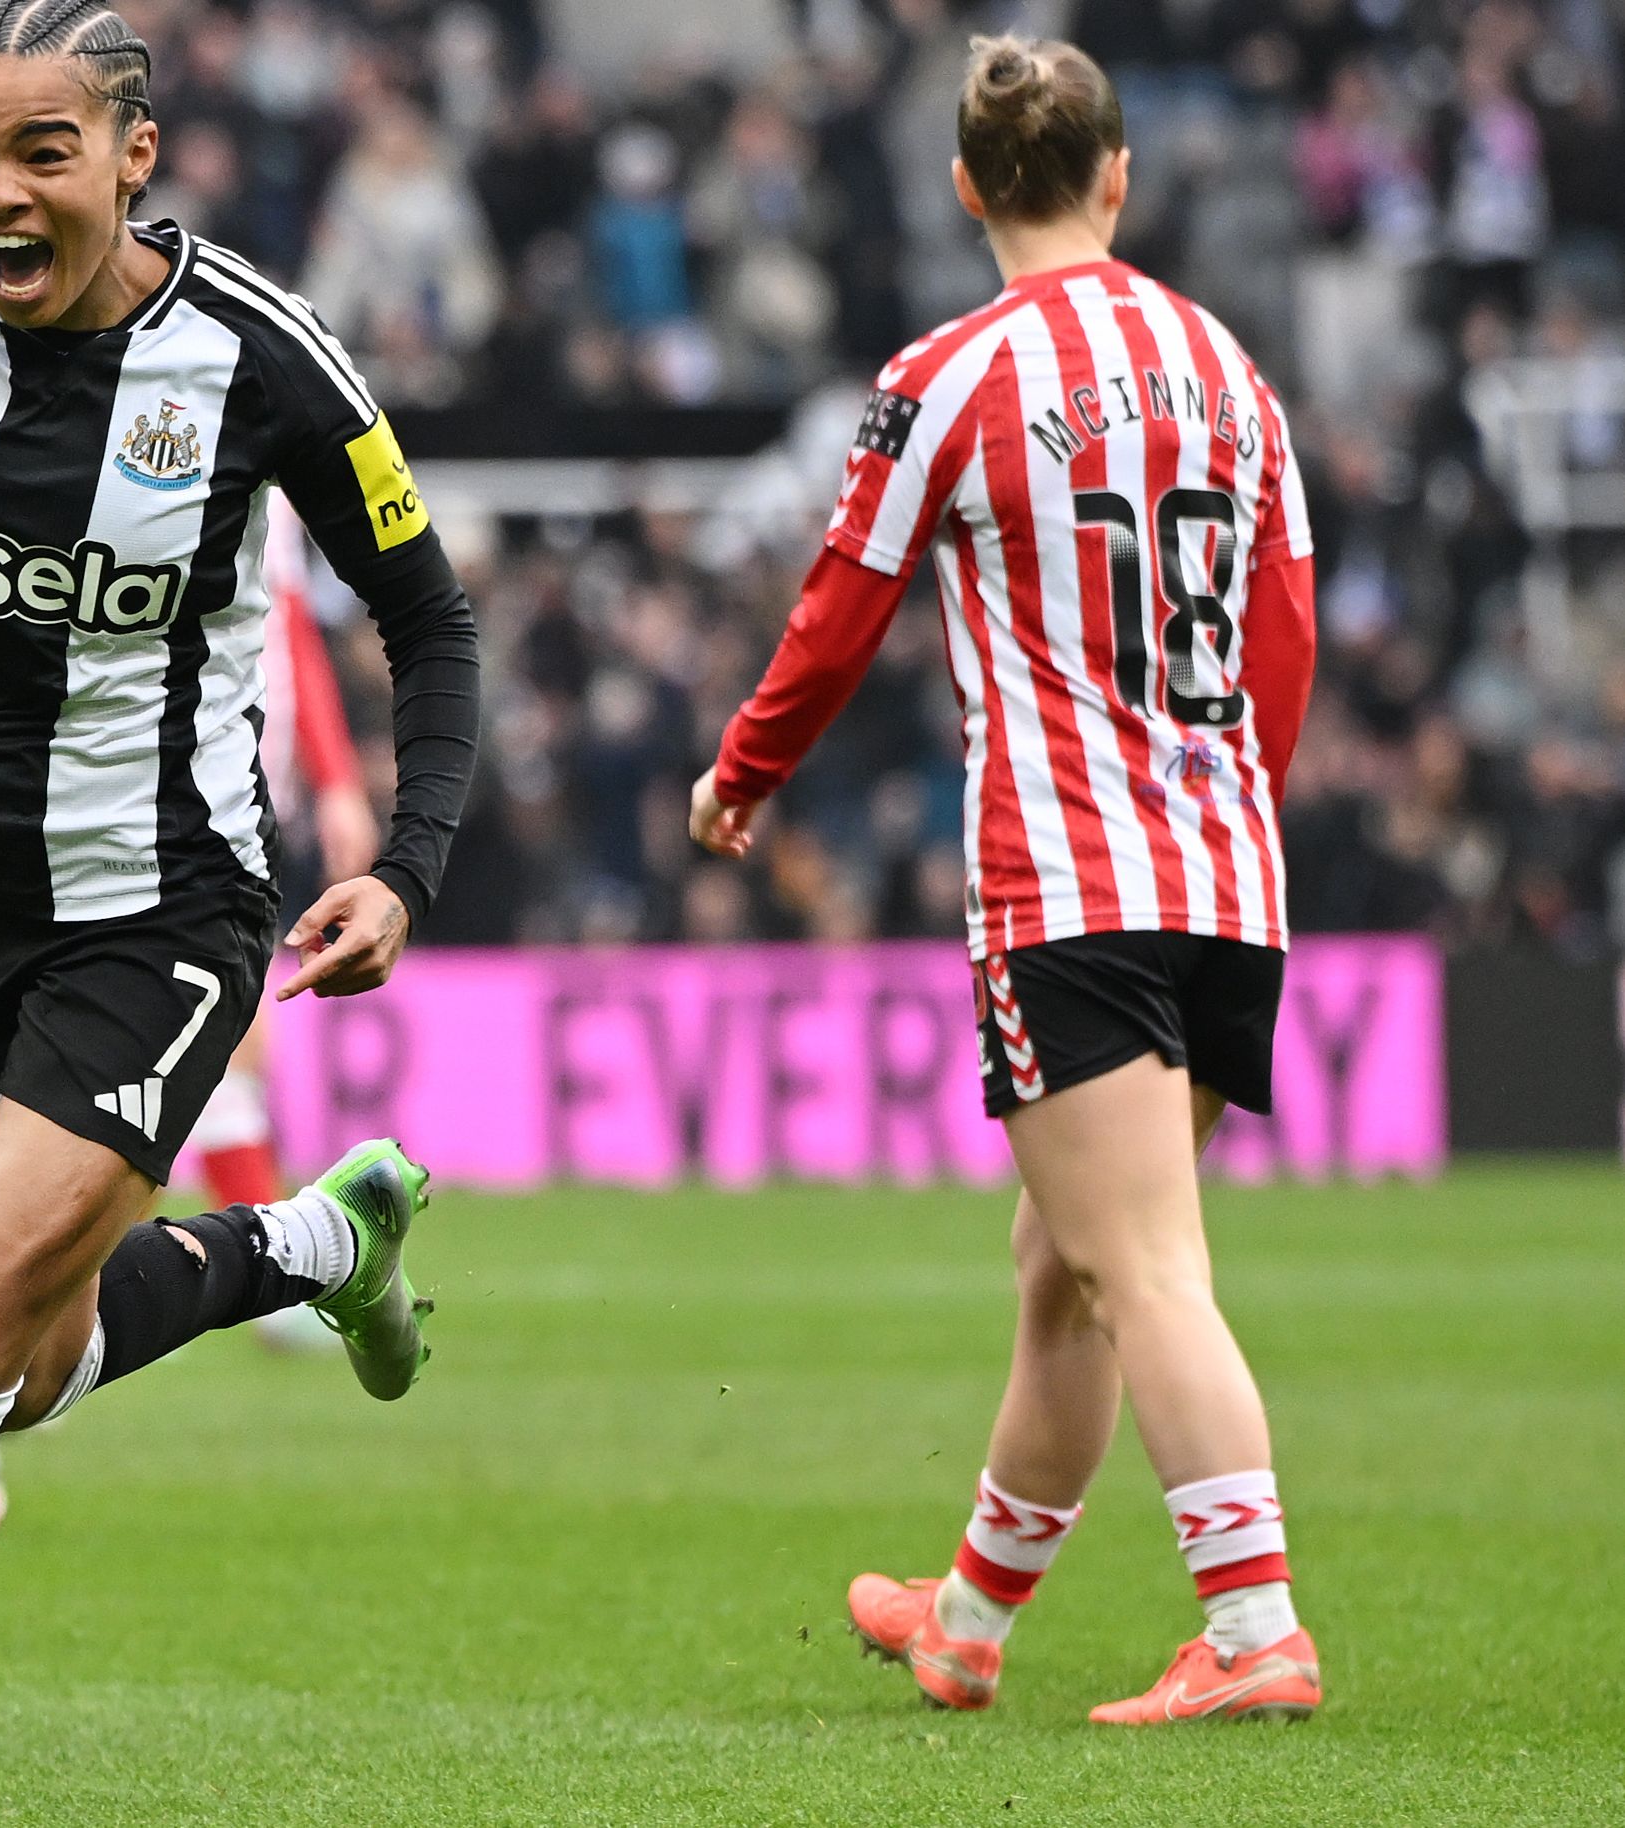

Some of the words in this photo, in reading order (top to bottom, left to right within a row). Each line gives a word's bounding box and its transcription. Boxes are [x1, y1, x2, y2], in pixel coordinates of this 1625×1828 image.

[1028, 369, 1263, 465] MCINNES
[378, 484, 420, 528] no
[1072, 487, 1245, 731] 18
[103, 860, 157, 873] HEAT.RD
[152, 961, 221, 1077] 7
